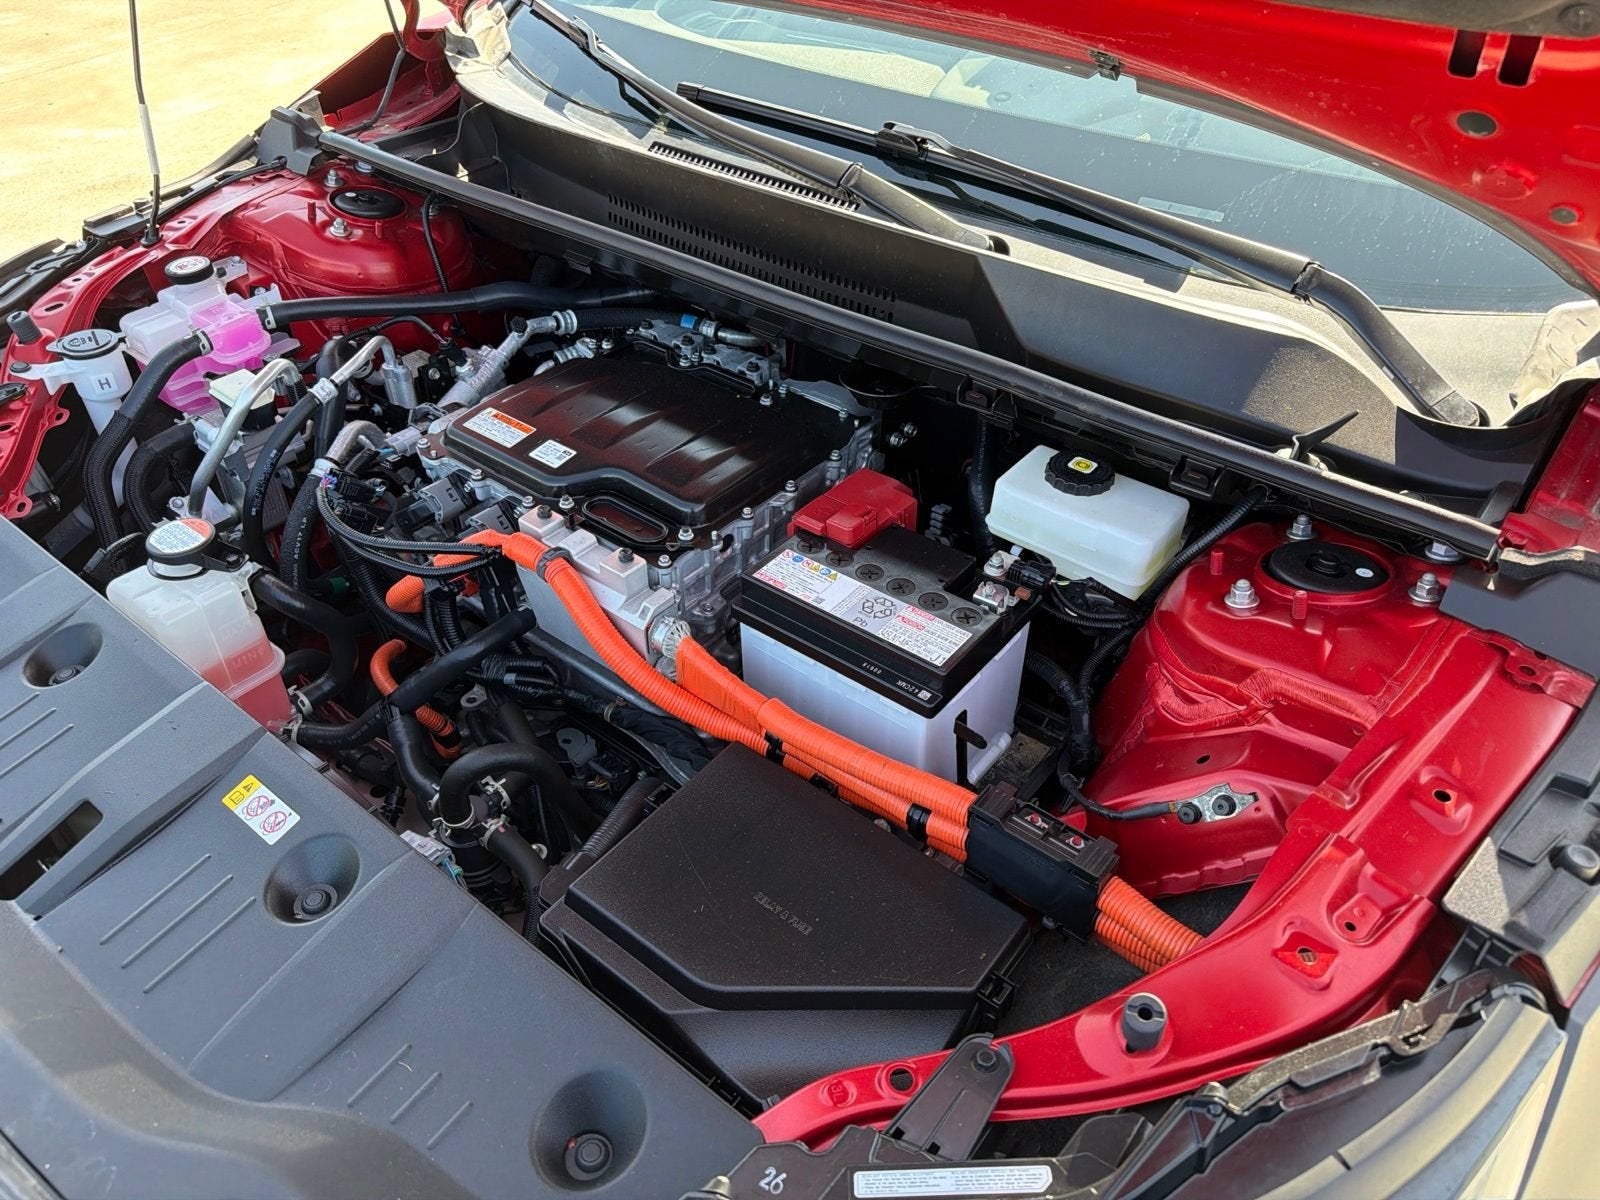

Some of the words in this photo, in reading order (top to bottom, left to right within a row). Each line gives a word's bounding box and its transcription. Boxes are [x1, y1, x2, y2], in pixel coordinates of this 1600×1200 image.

[98, 377, 112, 391] H
[293, 532, 303, 560] ACV17
[852, 616, 869, 628] Pb
[758, 1166, 788, 1195] 26
